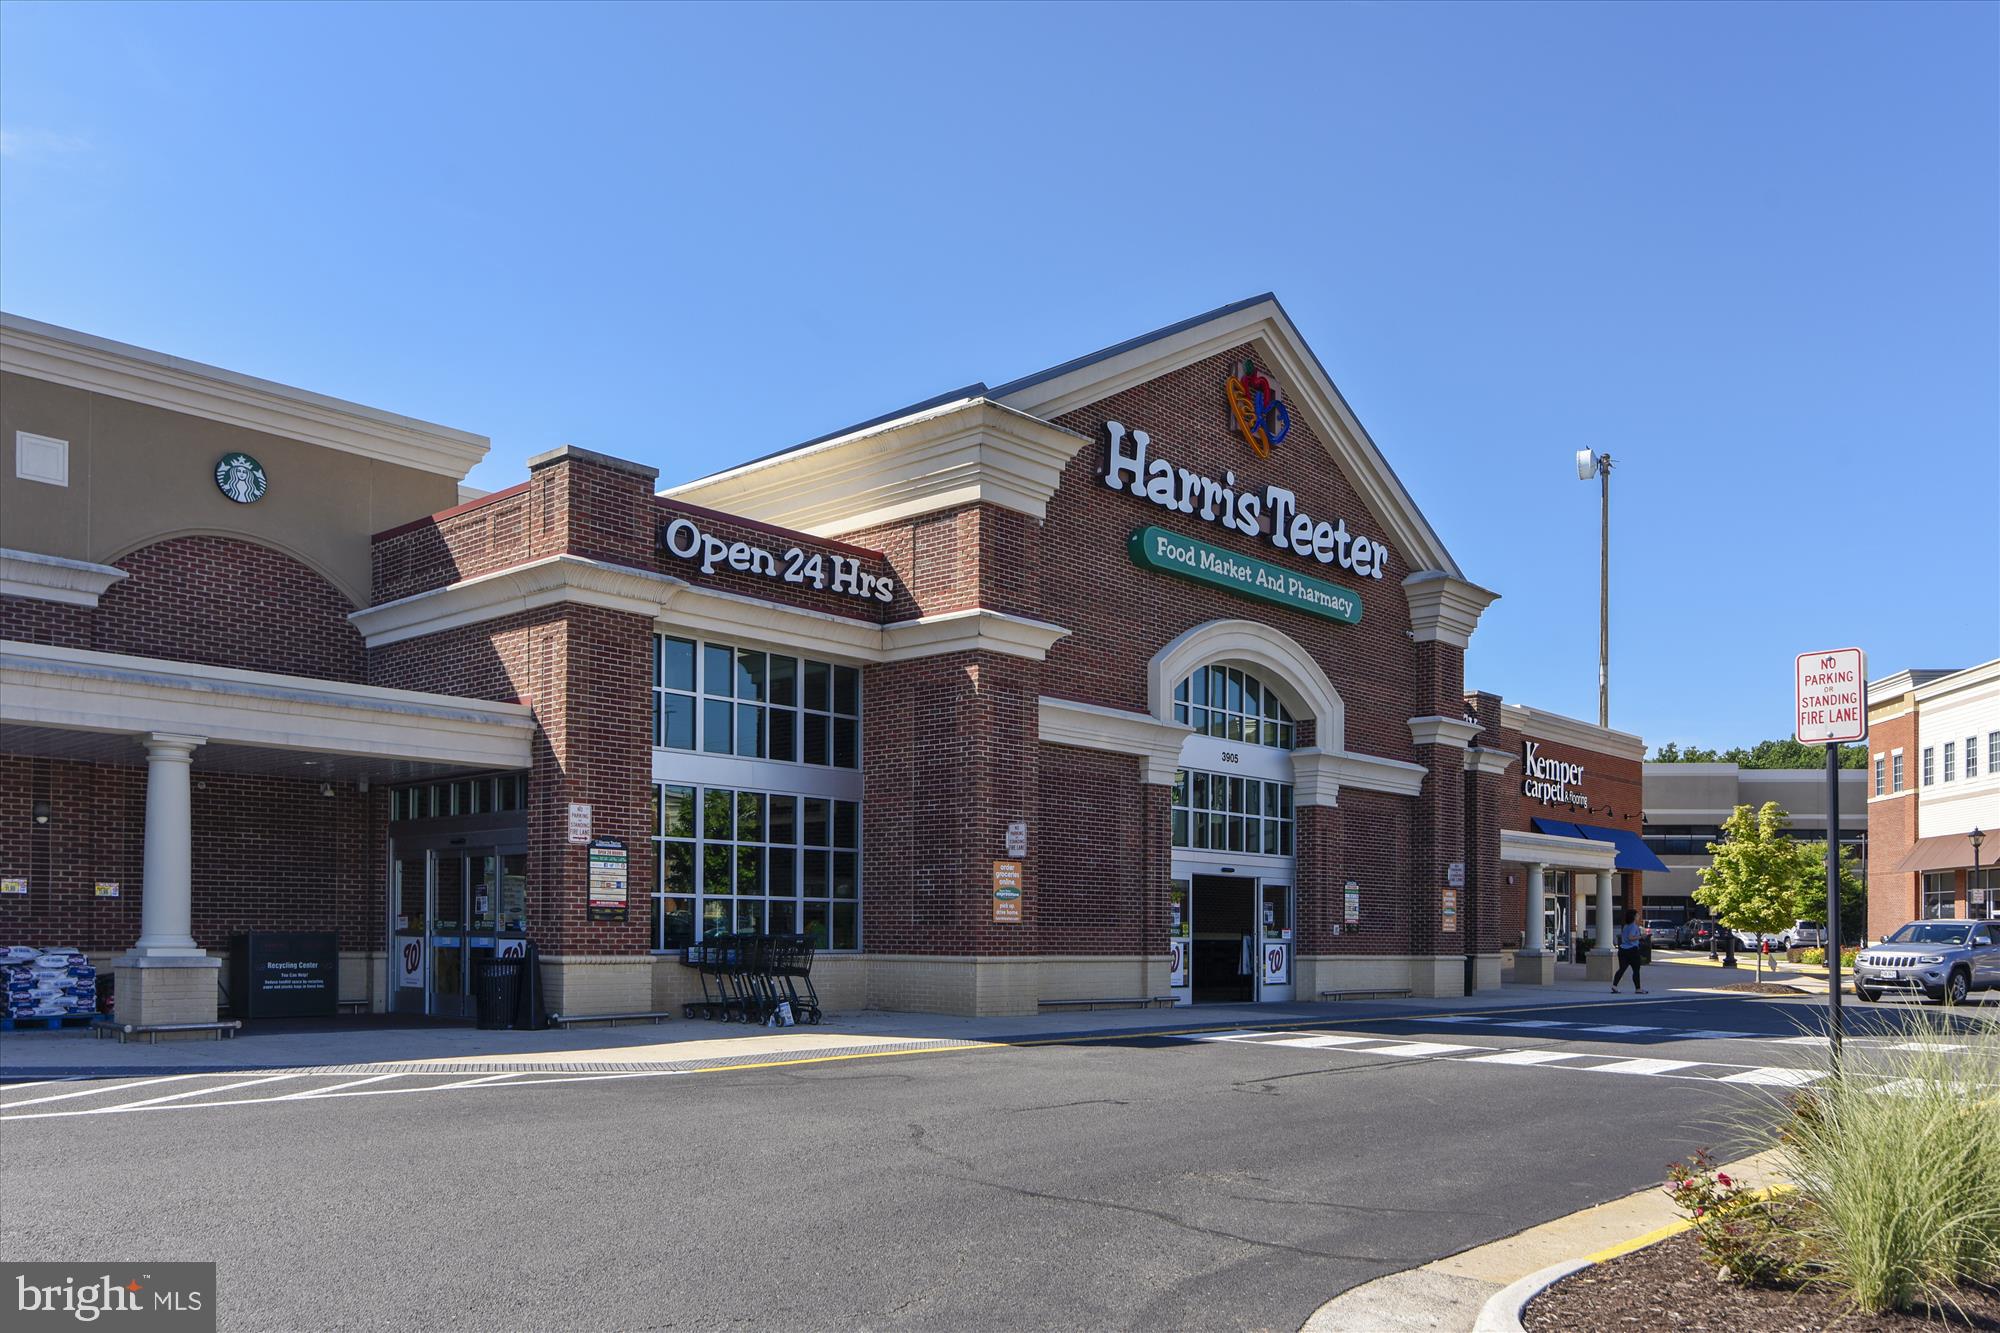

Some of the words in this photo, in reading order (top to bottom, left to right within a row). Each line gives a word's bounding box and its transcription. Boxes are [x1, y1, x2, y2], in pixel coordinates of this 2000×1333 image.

[1105, 420, 1260, 537] Harris
[1266, 485, 1388, 579] Teeter
[666, 518, 777, 576] Open
[783, 547, 825, 589] 24
[829, 555, 894, 602] Hrs
[1156, 536, 1196, 567] Food
[1199, 550, 1252, 582] Market
[1255, 571, 1285, 594] And
[1288, 577, 1353, 617] Pharmacy
[1820, 657, 1837, 670] NO
[1804, 670, 1854, 687] PARKING
[1801, 692, 1857, 709] STANDING
[1801, 710, 1825, 726] FIRE
[1829, 707, 1859, 723] LANE
[1221, 751, 1239, 764] 3905
[1525, 741, 1585, 801] Kemper
[1525, 779, 1561, 805] carpet
[1564, 791, 1569, 803] &
[1569, 790, 1588, 809] flooring
[267, 961, 297, 969] Recycling
[298, 961, 319, 969] Center
